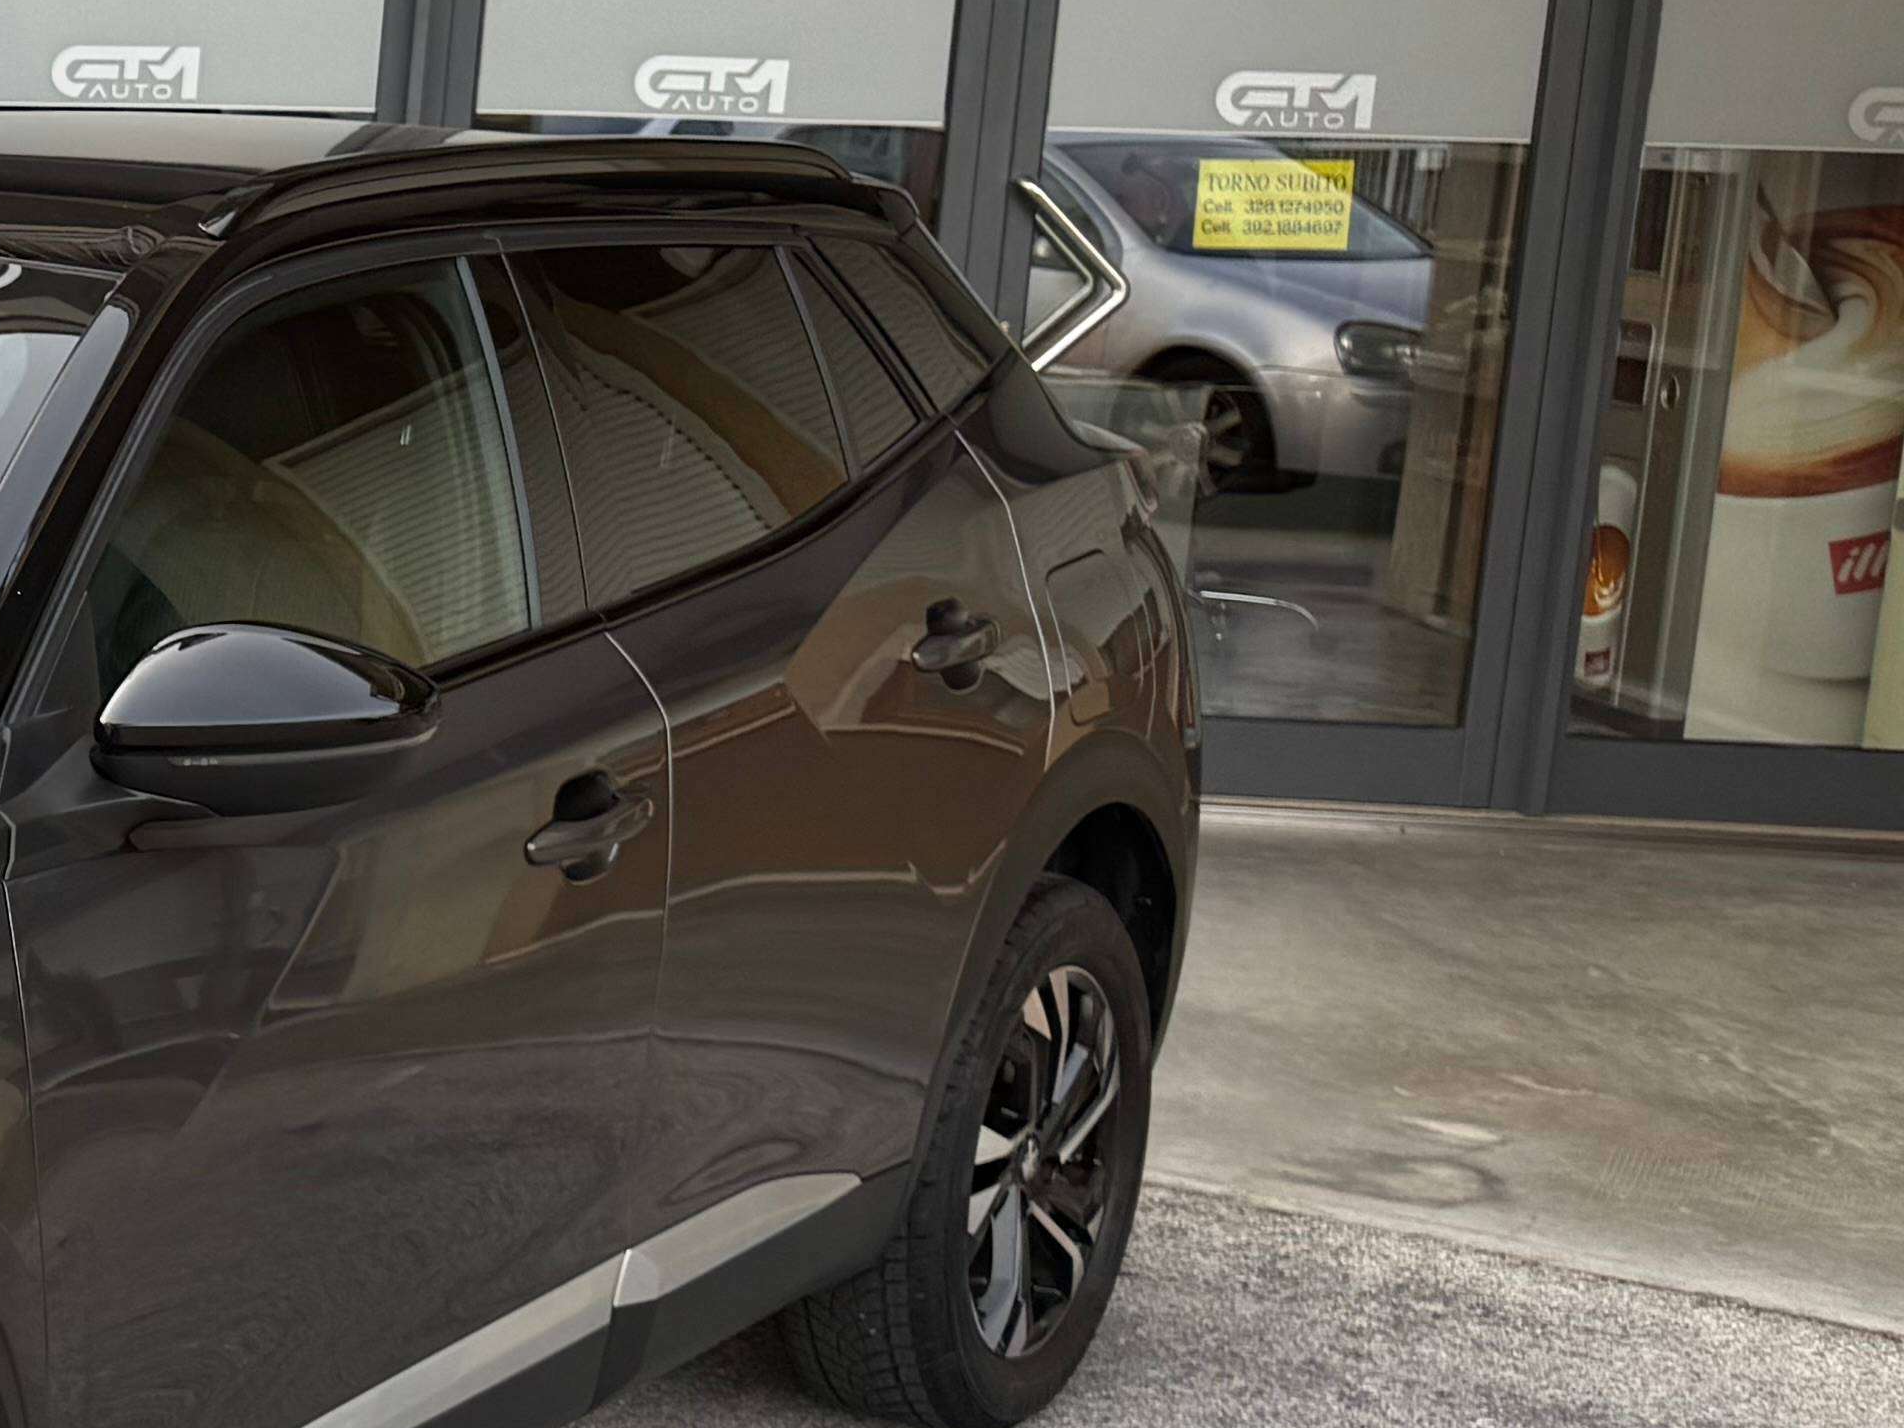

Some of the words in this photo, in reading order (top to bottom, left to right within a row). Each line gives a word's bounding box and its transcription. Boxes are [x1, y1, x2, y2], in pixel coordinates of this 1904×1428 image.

[88, 83, 172, 99] AUTO
[671, 95, 759, 112] AUTO
[1254, 111, 1344, 129] AUTO
[1208, 174, 1269, 193] TORNO
[1276, 174, 1347, 193] SUBITO
[1838, 542, 1889, 583] ill
